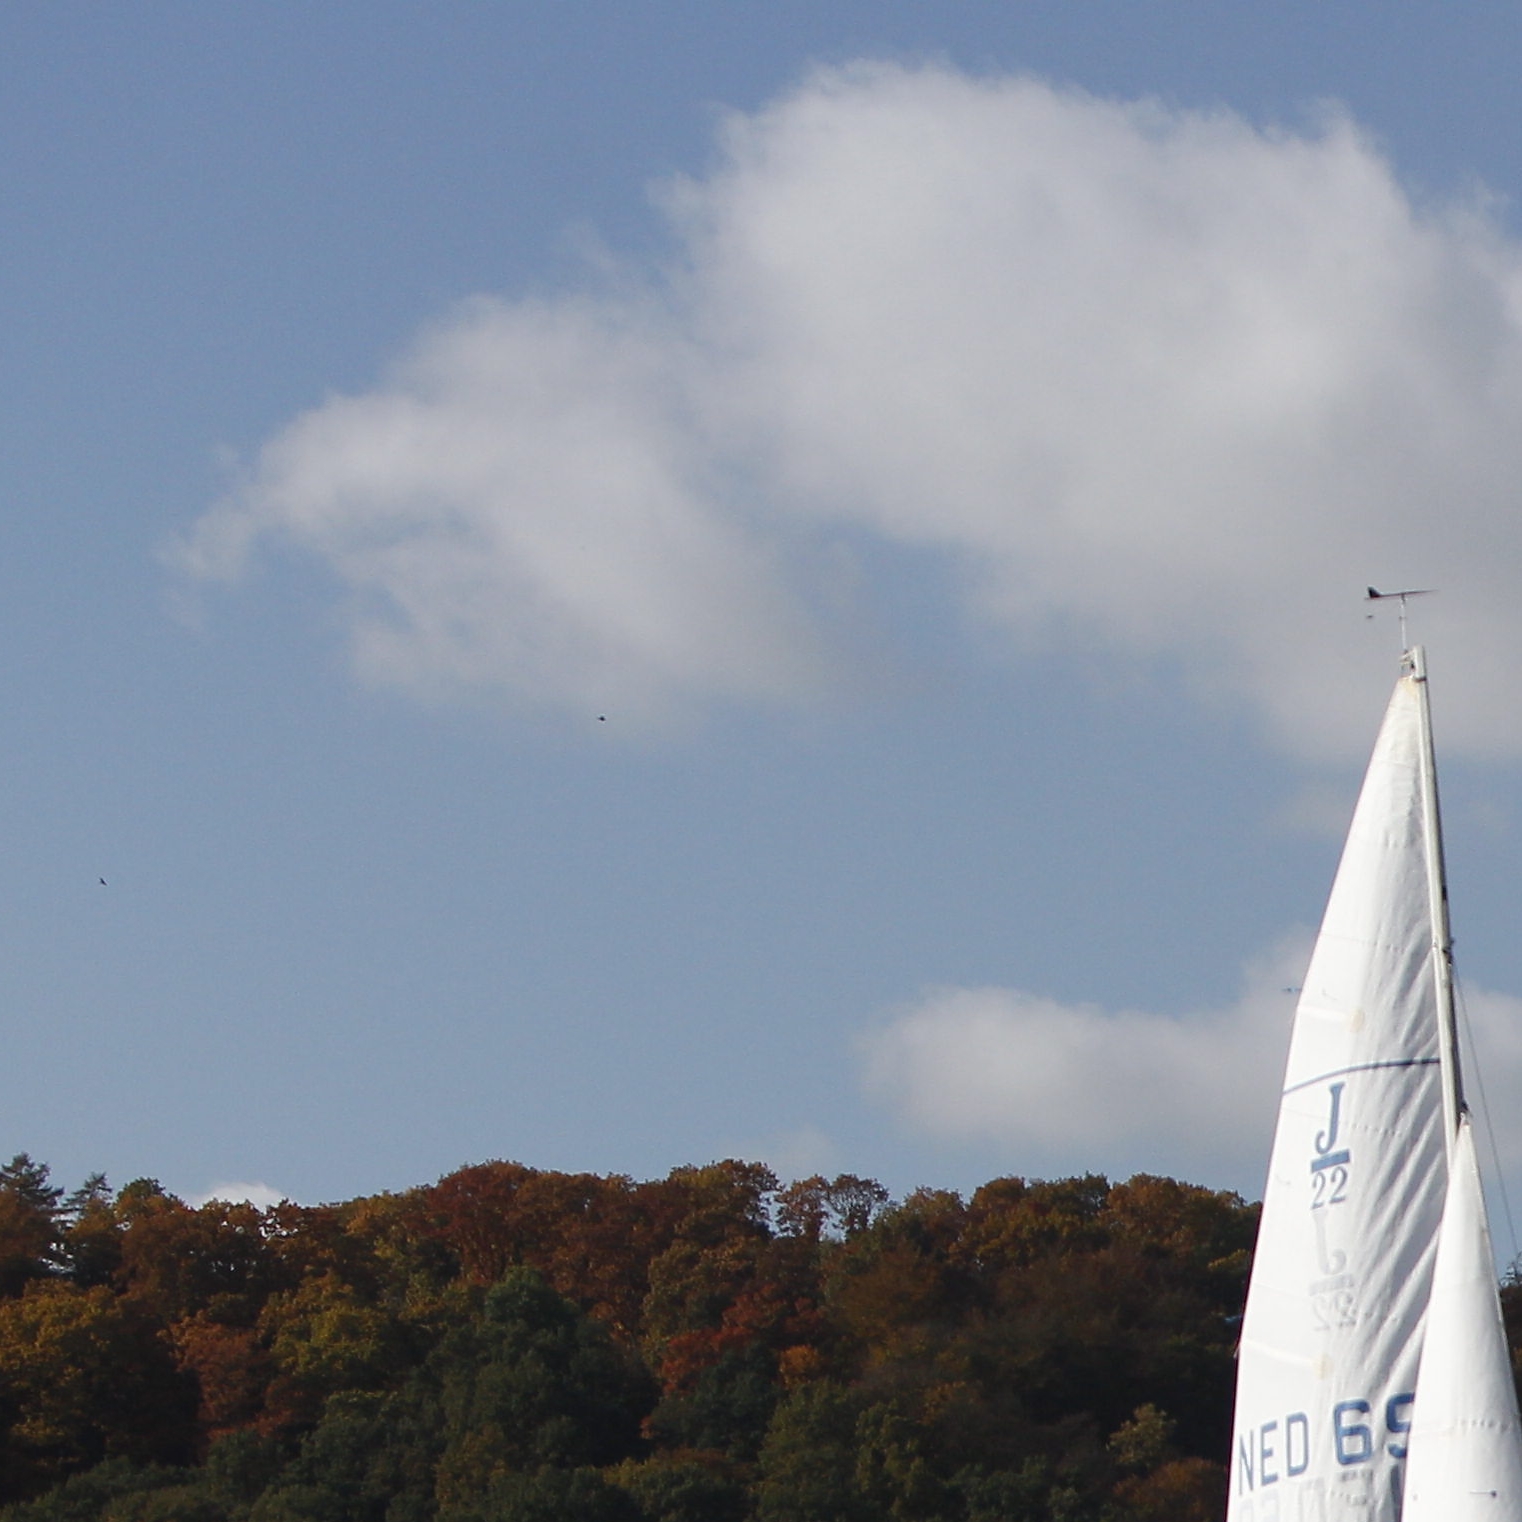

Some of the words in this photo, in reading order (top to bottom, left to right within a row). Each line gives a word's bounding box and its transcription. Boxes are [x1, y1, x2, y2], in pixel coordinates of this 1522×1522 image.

[1315, 1081, 1346, 1155] J
[1311, 1166, 1349, 1210] 22
[1239, 1411, 1309, 1496] NED
